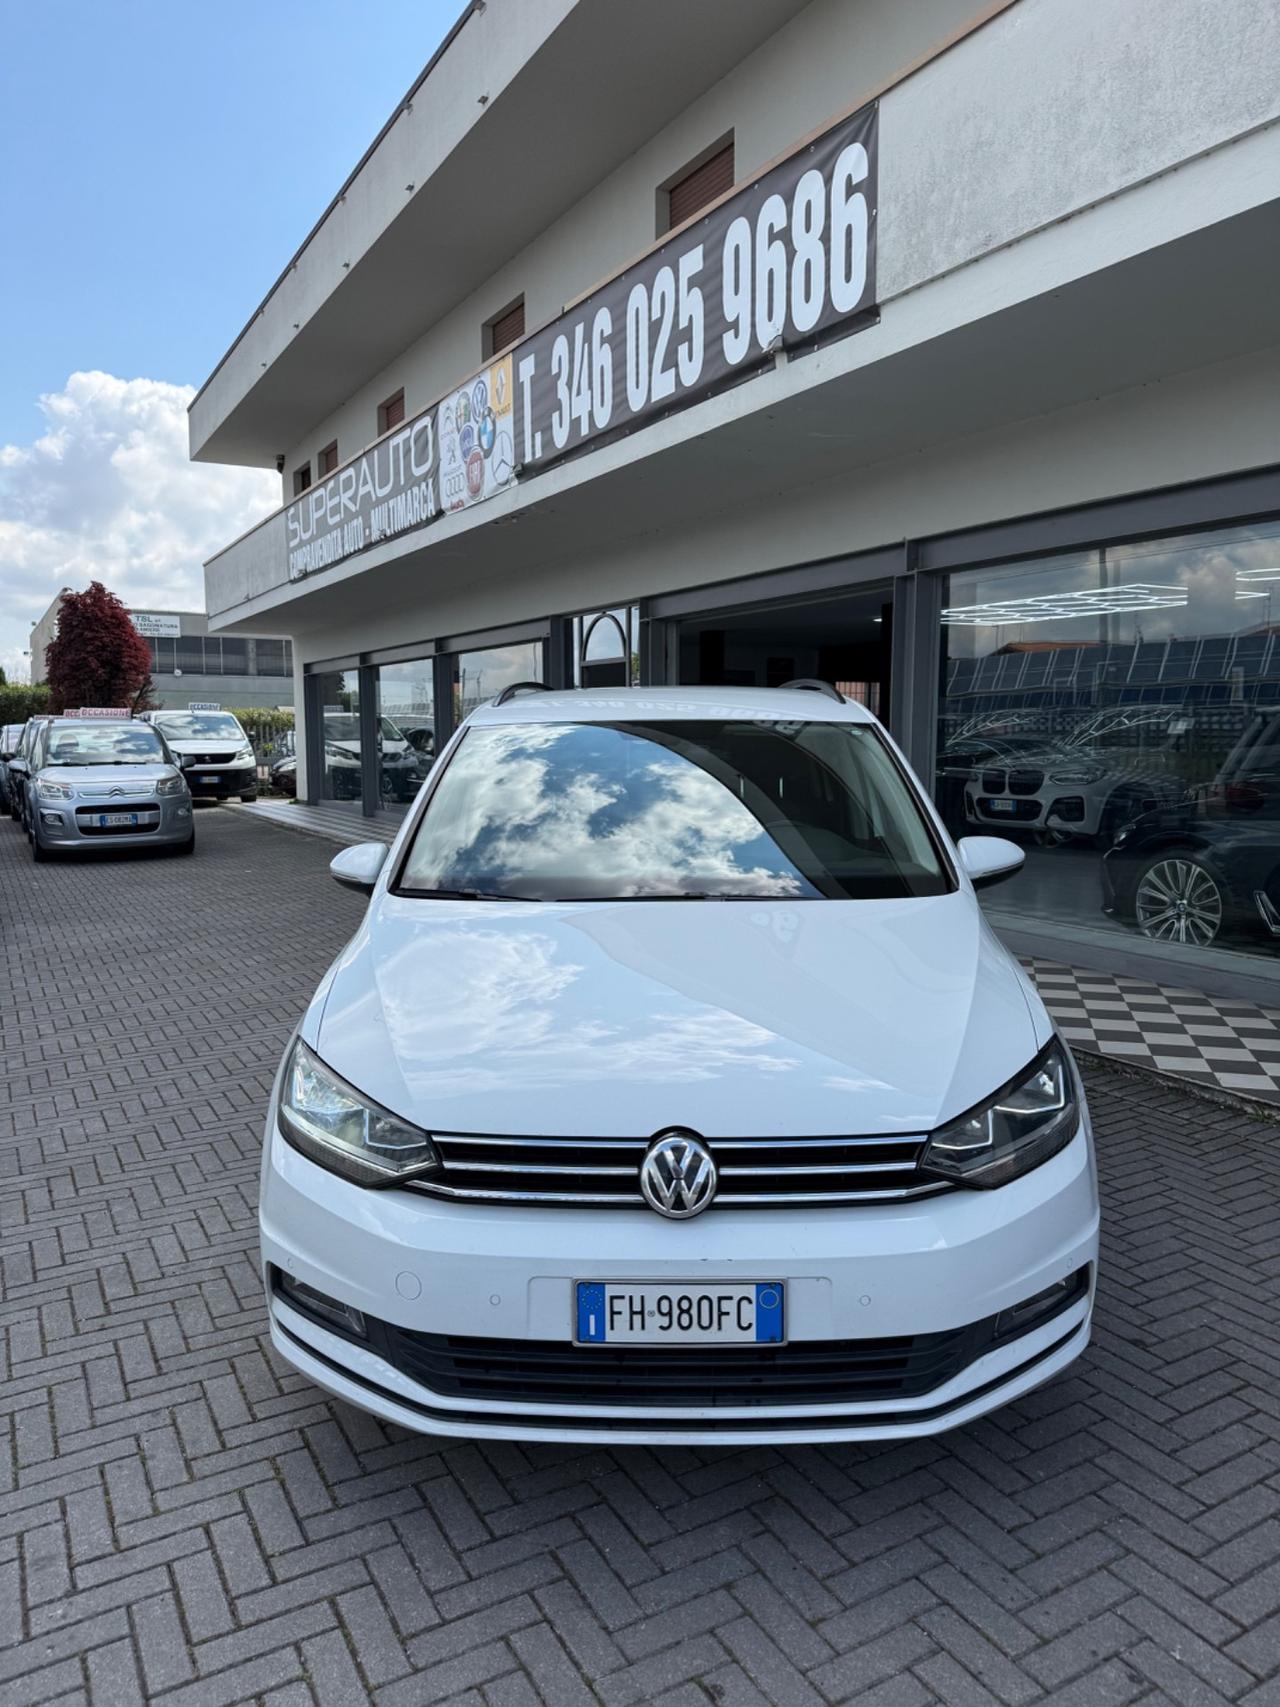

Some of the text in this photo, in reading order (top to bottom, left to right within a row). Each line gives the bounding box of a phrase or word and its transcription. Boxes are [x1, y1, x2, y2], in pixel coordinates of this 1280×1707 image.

[519, 142, 868, 463] T. 346 025 9686
[287, 415, 433, 548] SUPERAUTO
[344, 515, 363, 556] AUTO
[371, 478, 436, 543] MULTIMARCA
[81, 708, 130, 718] OCCASIONE
